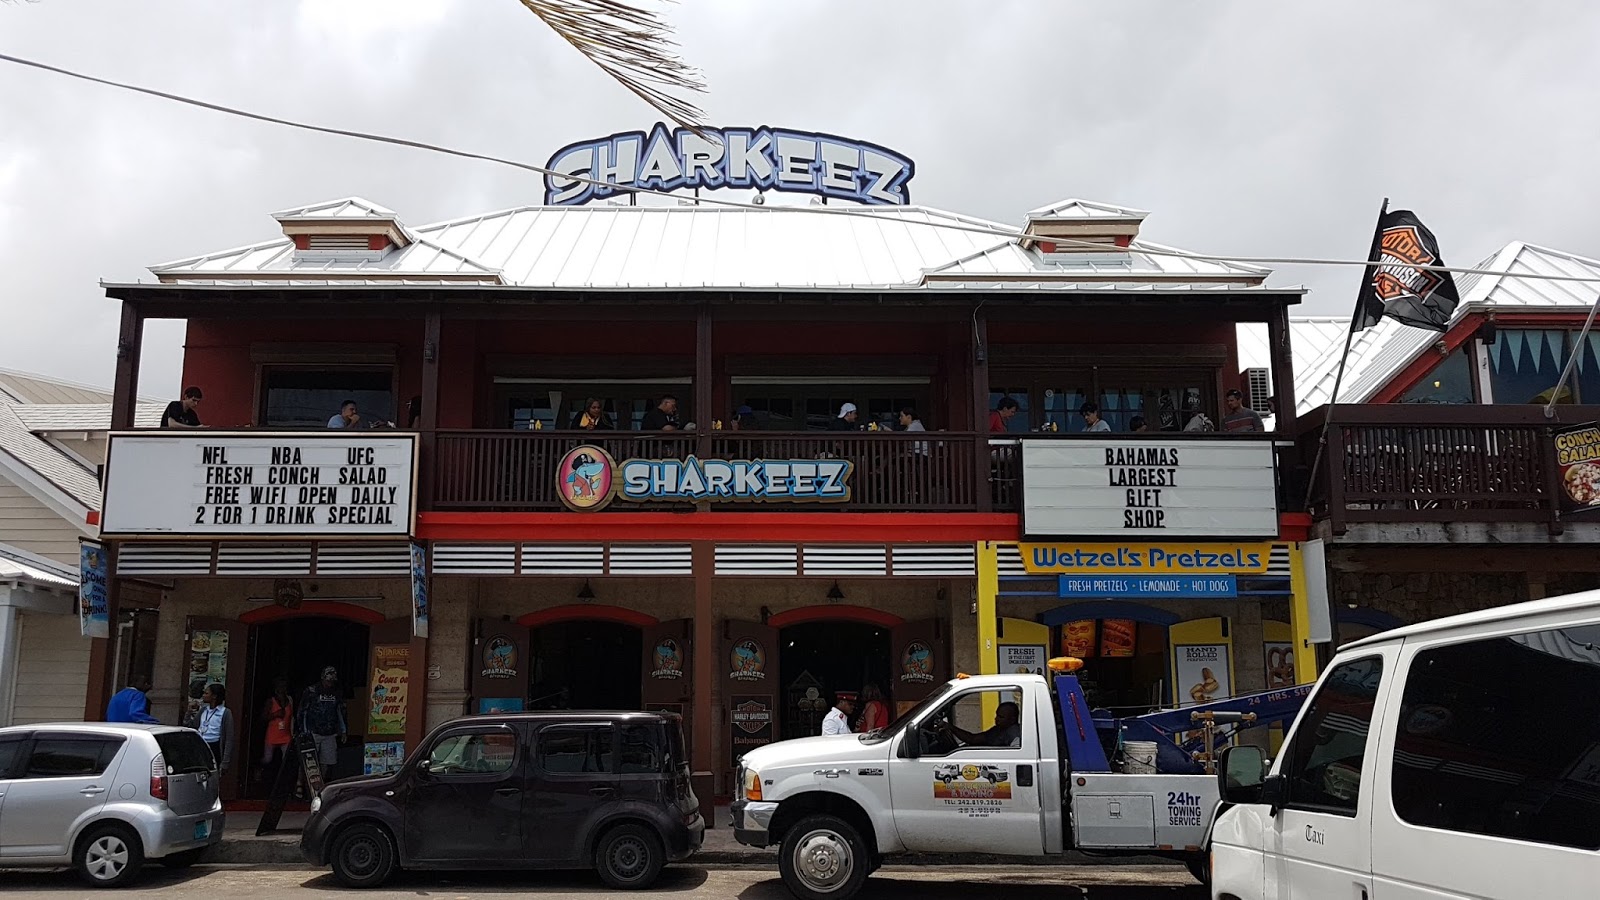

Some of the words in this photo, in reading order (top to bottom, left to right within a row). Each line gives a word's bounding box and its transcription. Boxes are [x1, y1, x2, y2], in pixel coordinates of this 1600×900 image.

[547, 124, 911, 205] SHARKEEZ
[1382, 231, 1421, 259] OTOR
[1557, 430, 1600, 449] CONCH
[202, 446, 228, 465] NFL
[271, 446, 302, 465] NBA
[347, 447, 375, 465] UFC
[1105, 448, 1179, 466] BAHAMAS
[206, 466, 252, 484] FRESH
[268, 466, 319, 484] CONCH
[338, 467, 387, 485] SALAD
[622, 455, 847, 498] SHARKEEZ
[1109, 468, 1177, 487] LARGEST
[205, 486, 240, 504] FREE
[251, 486, 287, 504] WIFI
[299, 486, 338, 505] OPEN
[351, 486, 398, 505] DAILY
[1126, 489, 1162, 507] GIFT
[195, 506, 205, 524] 2
[213, 506, 242, 524] FOR
[251, 506, 258, 524] 1
[265, 506, 316, 524] DRINK
[328, 506, 393, 524] SPECIAL
[1124, 509, 1166, 528] SHOP
[1033, 547, 1142, 567] Wetzel's
[1149, 548, 1261, 568] Pretzels
[1068, 580, 1091, 592] FRESH
[1093, 580, 1128, 592] PRETZELS
[1139, 580, 1180, 592] LEMONADE
[1192, 580, 1207, 592] HOT
[1209, 580, 1229, 592] DOGS
[1247, 696, 1261, 706] 24
[1267, 691, 1291, 702] HRS.
[381, 705, 400, 714] BITE
[1167, 791, 1201, 805] 24hr
[1167, 806, 1202, 817] TOWING
[1169, 816, 1201, 826] SERVICE
[1305, 824, 1325, 846] Taxi
